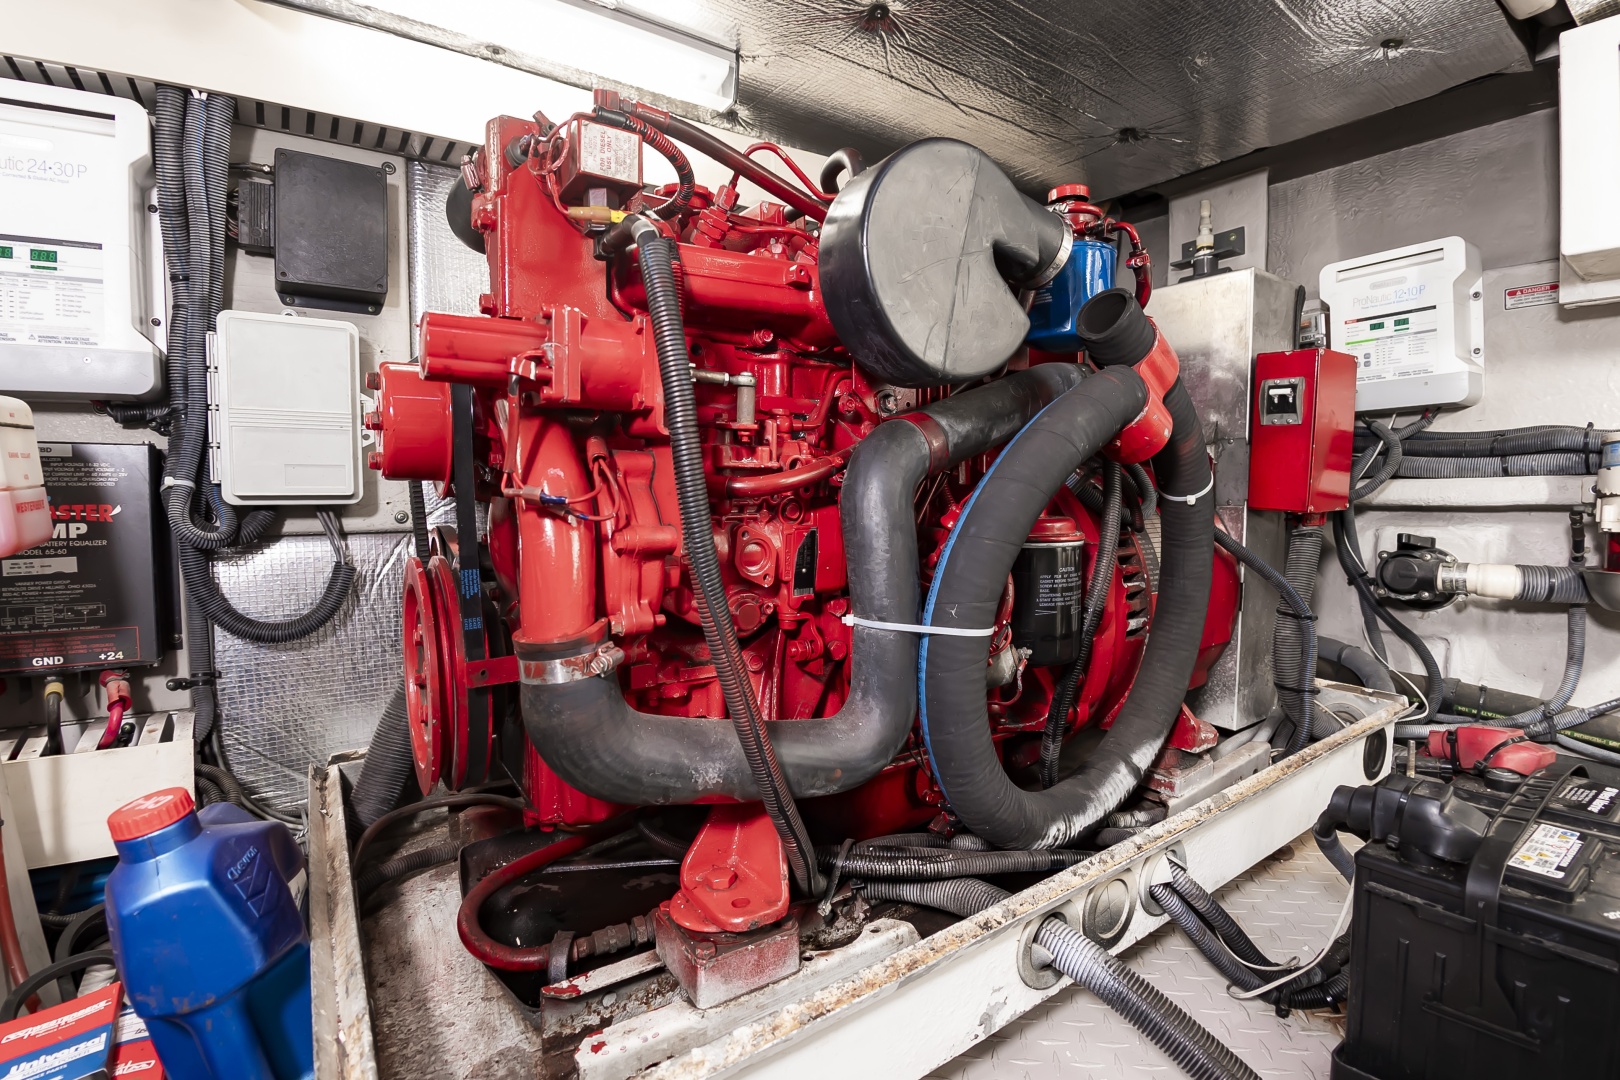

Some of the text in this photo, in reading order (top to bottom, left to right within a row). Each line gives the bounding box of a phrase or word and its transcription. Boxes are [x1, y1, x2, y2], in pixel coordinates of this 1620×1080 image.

[1522, 285, 1551, 294] DANGER
[1353, 292, 1392, 308] ProNautic
[32, 655, 64, 667] GND
[98, 650, 125, 661] +24
[9, 1032, 107, 1076] Universal
[46, 1064, 68, 1075] PARTS
